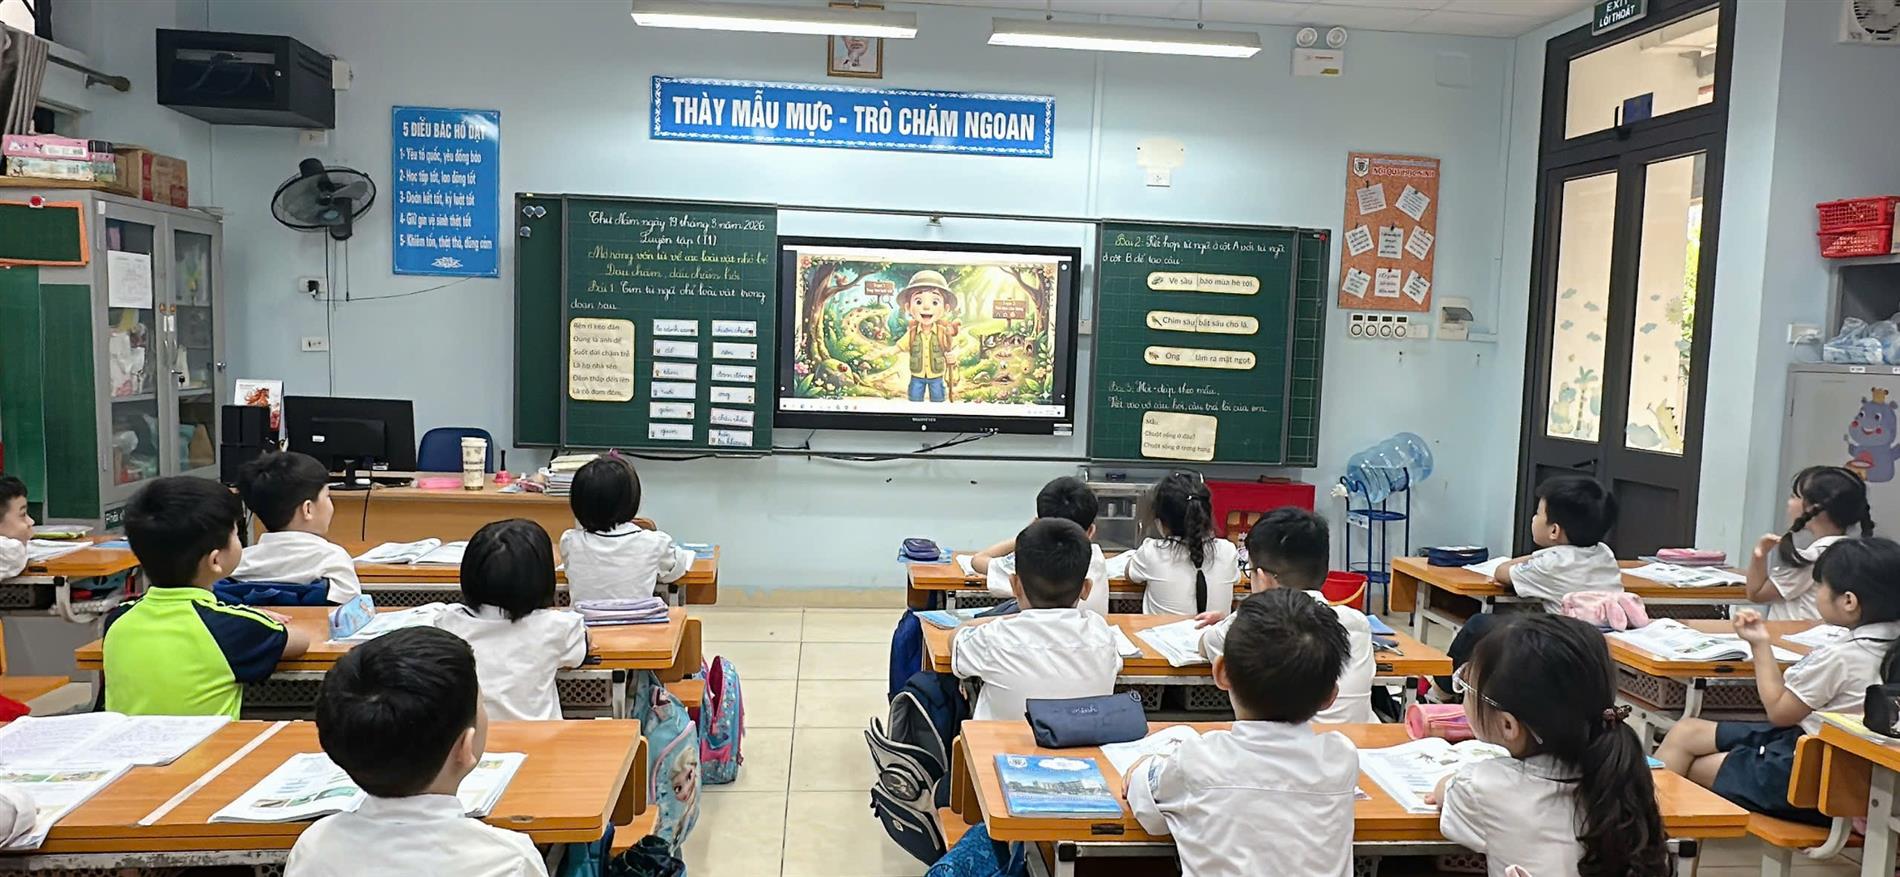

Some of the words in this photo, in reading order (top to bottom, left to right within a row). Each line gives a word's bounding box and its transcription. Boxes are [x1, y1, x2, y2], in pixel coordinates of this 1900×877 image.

[672, 91, 726, 126] THÀY
[731, 89, 780, 129] MẪU
[785, 101, 833, 137] MỰC
[854, 101, 892, 135] TRÒ
[898, 105, 958, 142] CHĂM
[964, 110, 1036, 142] NGOAN
[403, 122, 409, 137] 5
[411, 116, 431, 138] ĐIỀU
[433, 120, 451, 138] BÁC
[454, 118, 467, 139] HỒ
[406, 147, 417, 161] Yêu
[443, 149, 454, 164] yêu
[400, 169, 405, 182] 2-
[406, 169, 418, 185] Học
[441, 171, 451, 183] lao
[467, 170, 476, 184] tốt
[400, 190, 405, 204] 3-
[423, 189, 433, 205] kết
[466, 191, 475, 206] tốt
[436, 214, 449, 227] sinh
[462, 212, 472, 227] tốt
[680, 214, 709, 234] tháng
[718, 220, 742, 230] năm
[743, 219, 766, 231] 2026
[406, 234, 425, 247] Khiêm
[1232, 241, 1239, 251] A
[1125, 252, 1133, 263] B
[1169, 277, 1180, 285] Ve
[741, 289, 766, 304] trong
[1162, 316, 1181, 325] Chim
[1226, 320, 1239, 329] cho
[1165, 353, 1180, 361] Ong
